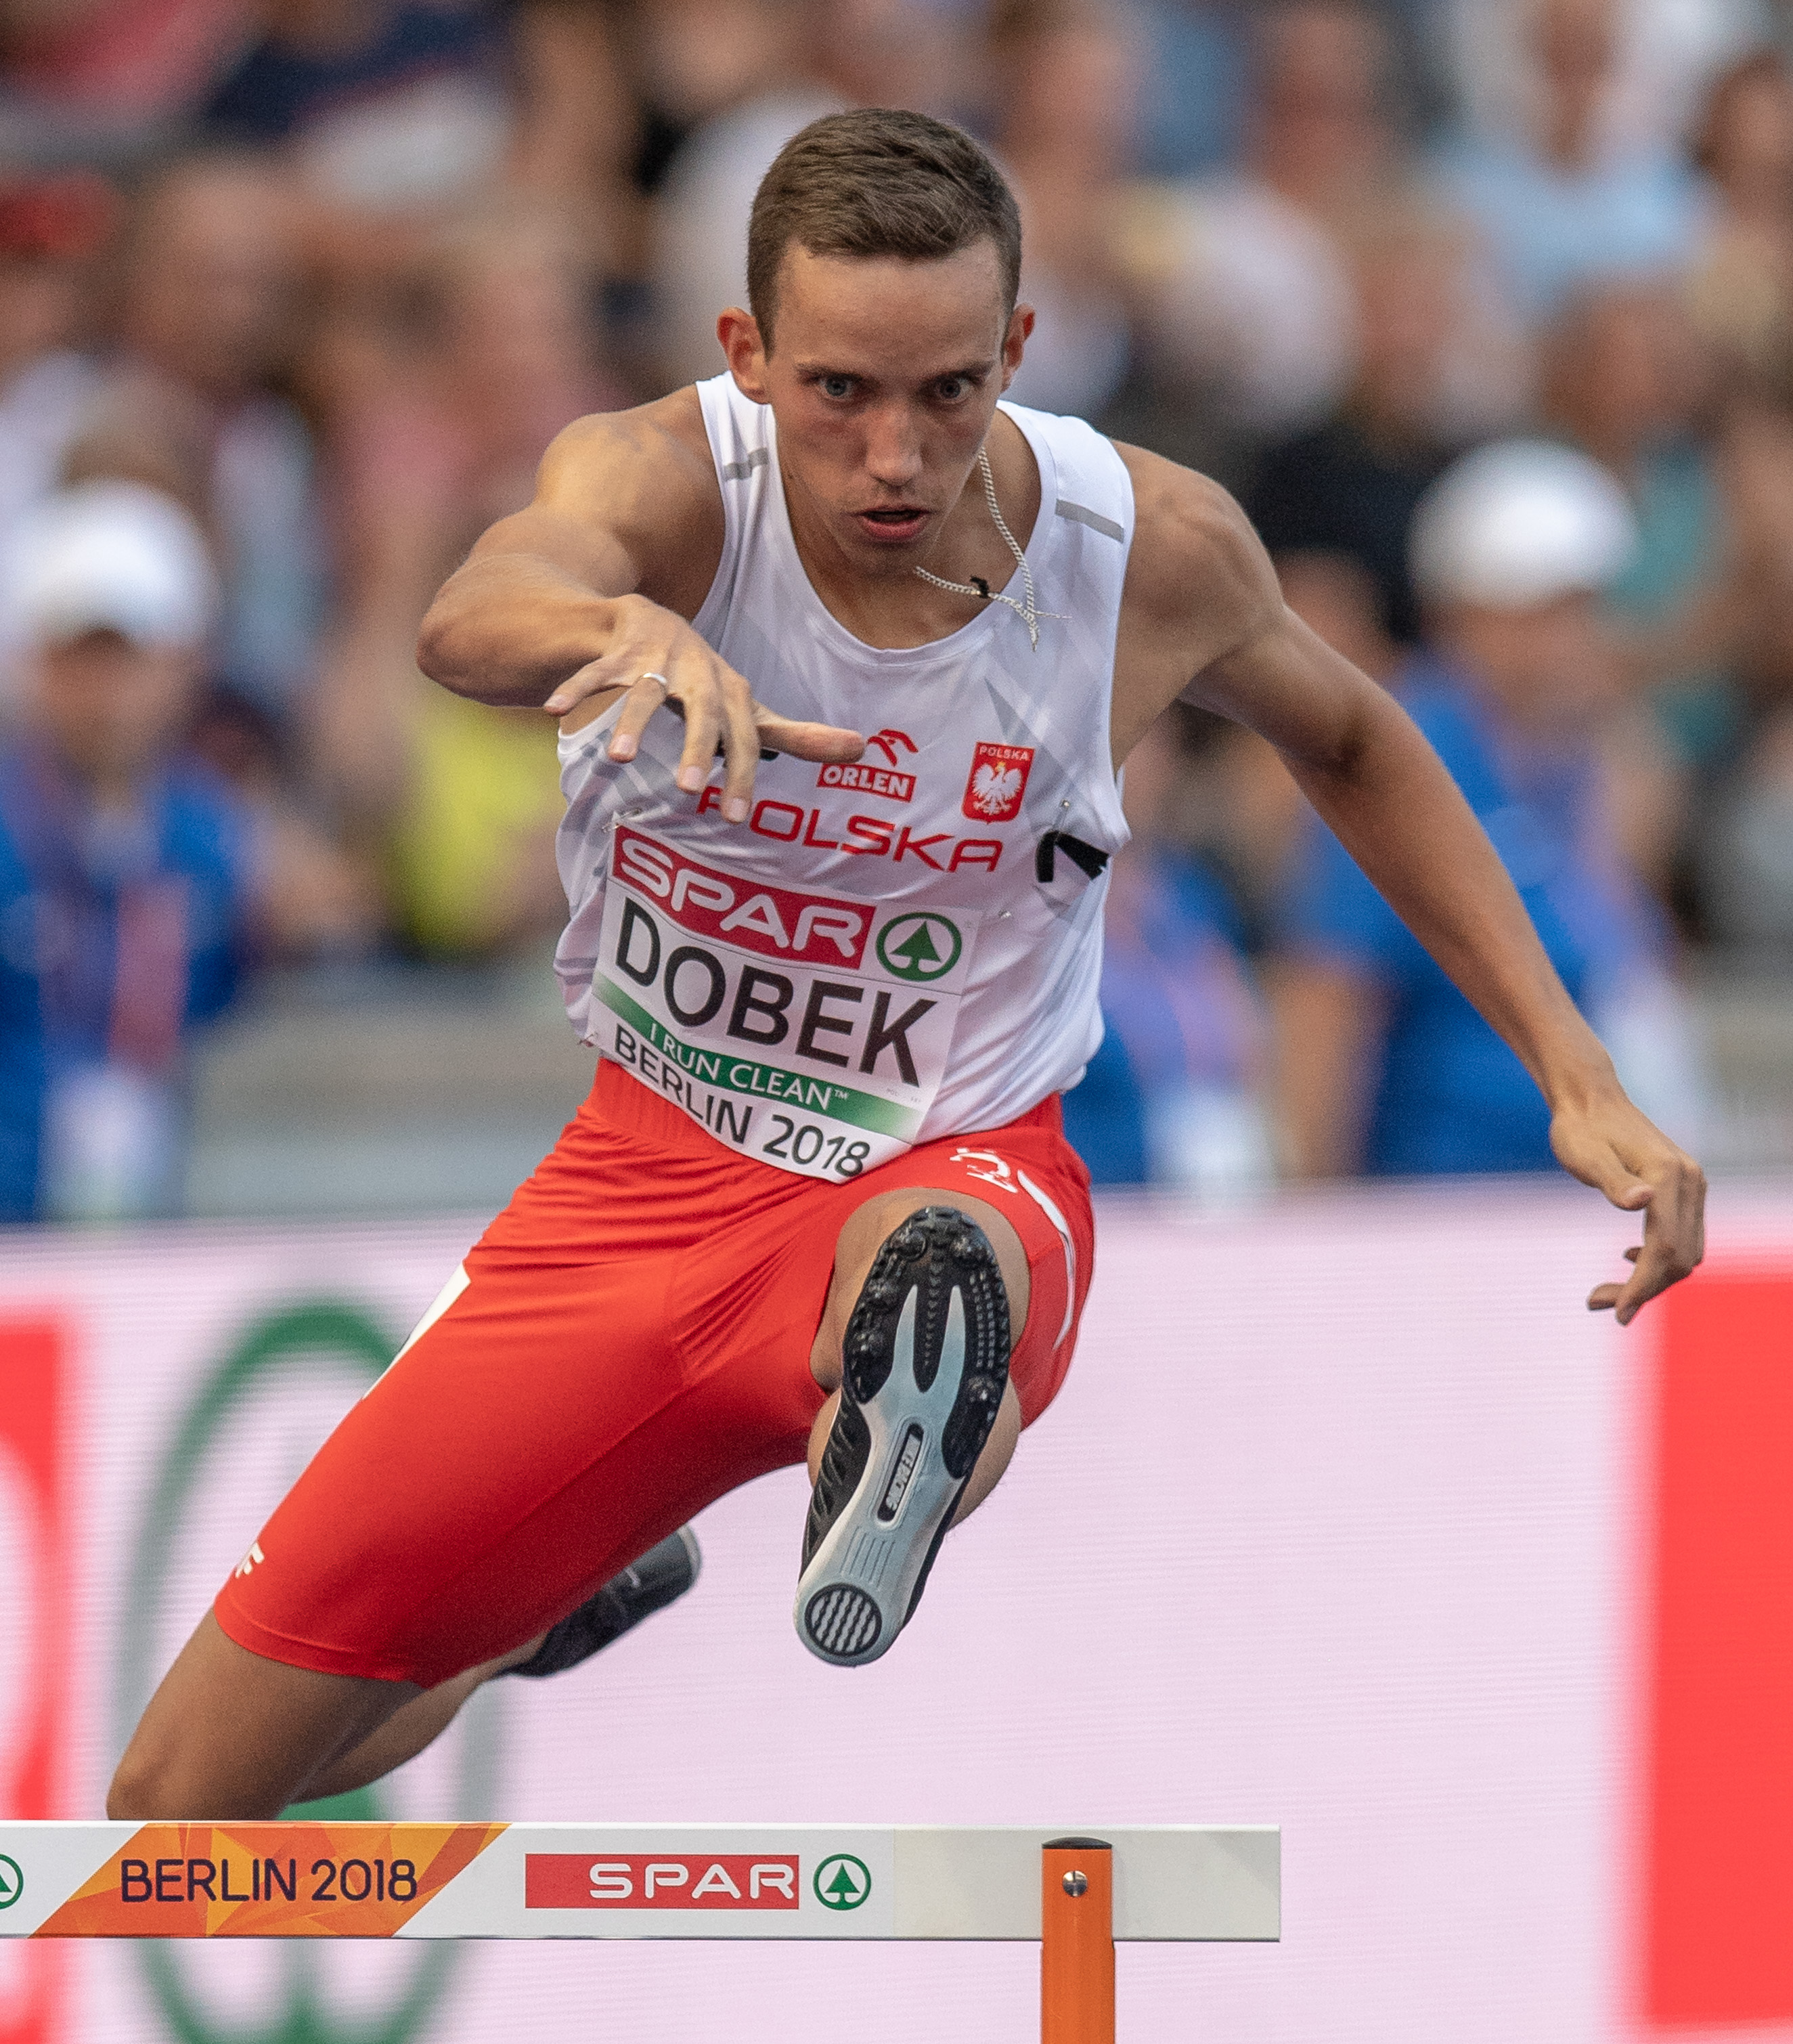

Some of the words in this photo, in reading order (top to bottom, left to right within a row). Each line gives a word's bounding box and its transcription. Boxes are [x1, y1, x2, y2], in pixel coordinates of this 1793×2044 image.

[979, 745, 1029, 761] POLSKA
[823, 764, 909, 797] ORLEN
[620, 837, 866, 957] SPAR
[615, 897, 937, 1087] DOBEK
[649, 1022, 656, 1041] I
[663, 1040, 722, 1081] RUN
[615, 1023, 753, 1144] BERLIN
[763, 1114, 871, 1177] 2018
[120, 1858, 296, 1902] BERLIN
[311, 1858, 418, 1902] 2018
[590, 1863, 795, 1900] SPAR
